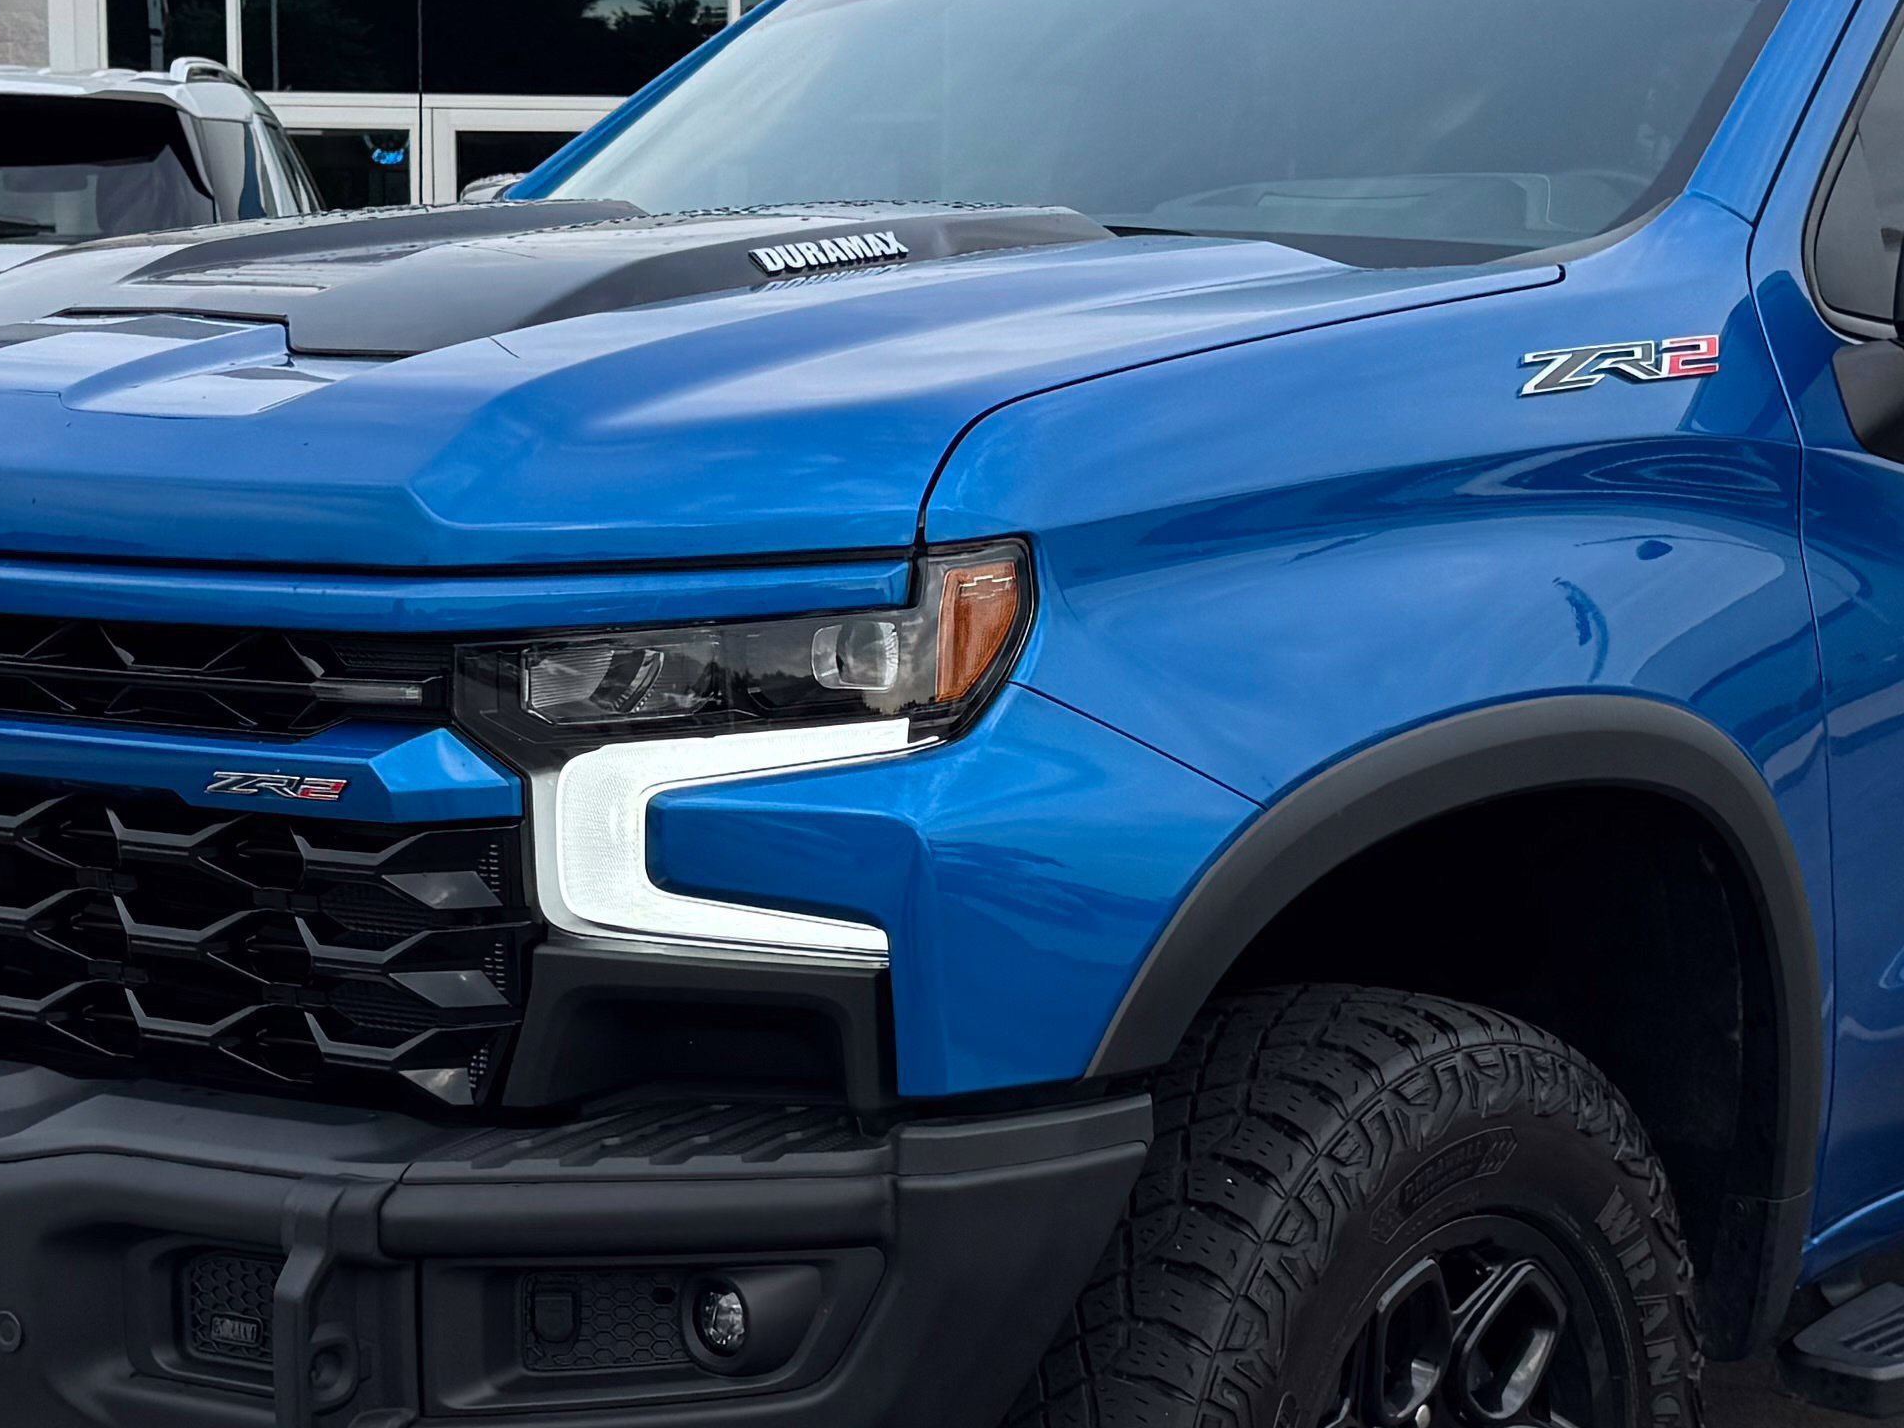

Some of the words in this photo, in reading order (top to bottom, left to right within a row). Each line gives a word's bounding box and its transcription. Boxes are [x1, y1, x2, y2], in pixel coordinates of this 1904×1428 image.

[749, 231, 909, 275] DURAMAX
[1516, 334, 1719, 398] ZR2
[205, 771, 348, 801] ZR2
